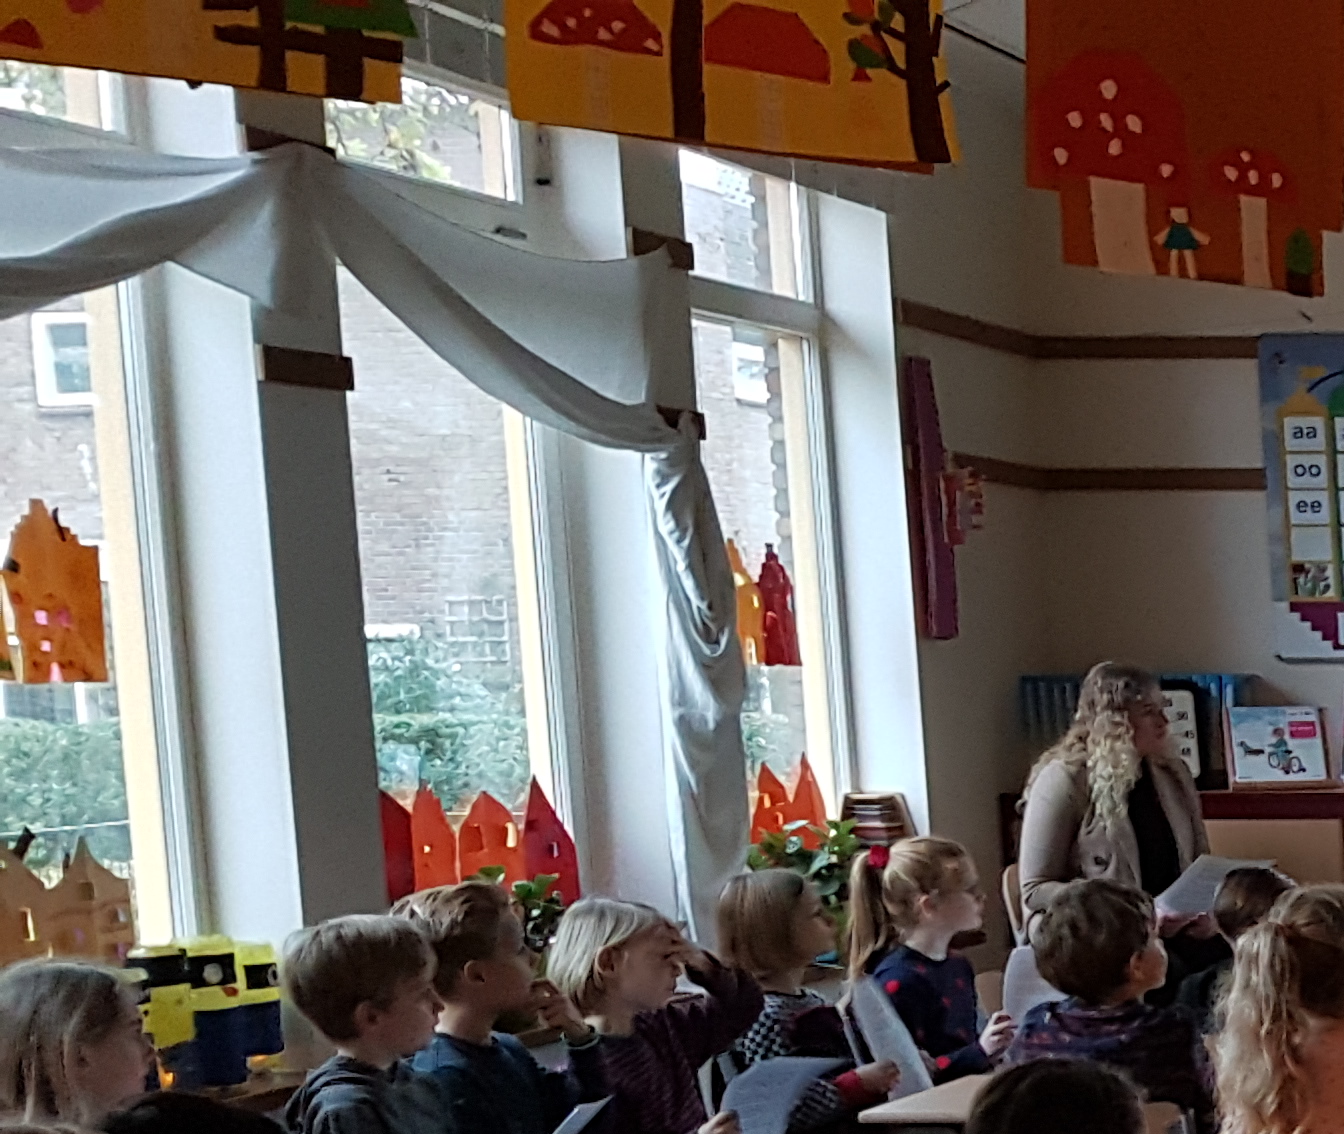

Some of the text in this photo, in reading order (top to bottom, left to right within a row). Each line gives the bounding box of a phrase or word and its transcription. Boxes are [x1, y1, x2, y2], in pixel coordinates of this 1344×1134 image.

[1292, 425, 1318, 440] aa
[1293, 463, 1322, 478] oo
[1295, 499, 1323, 514] ee
